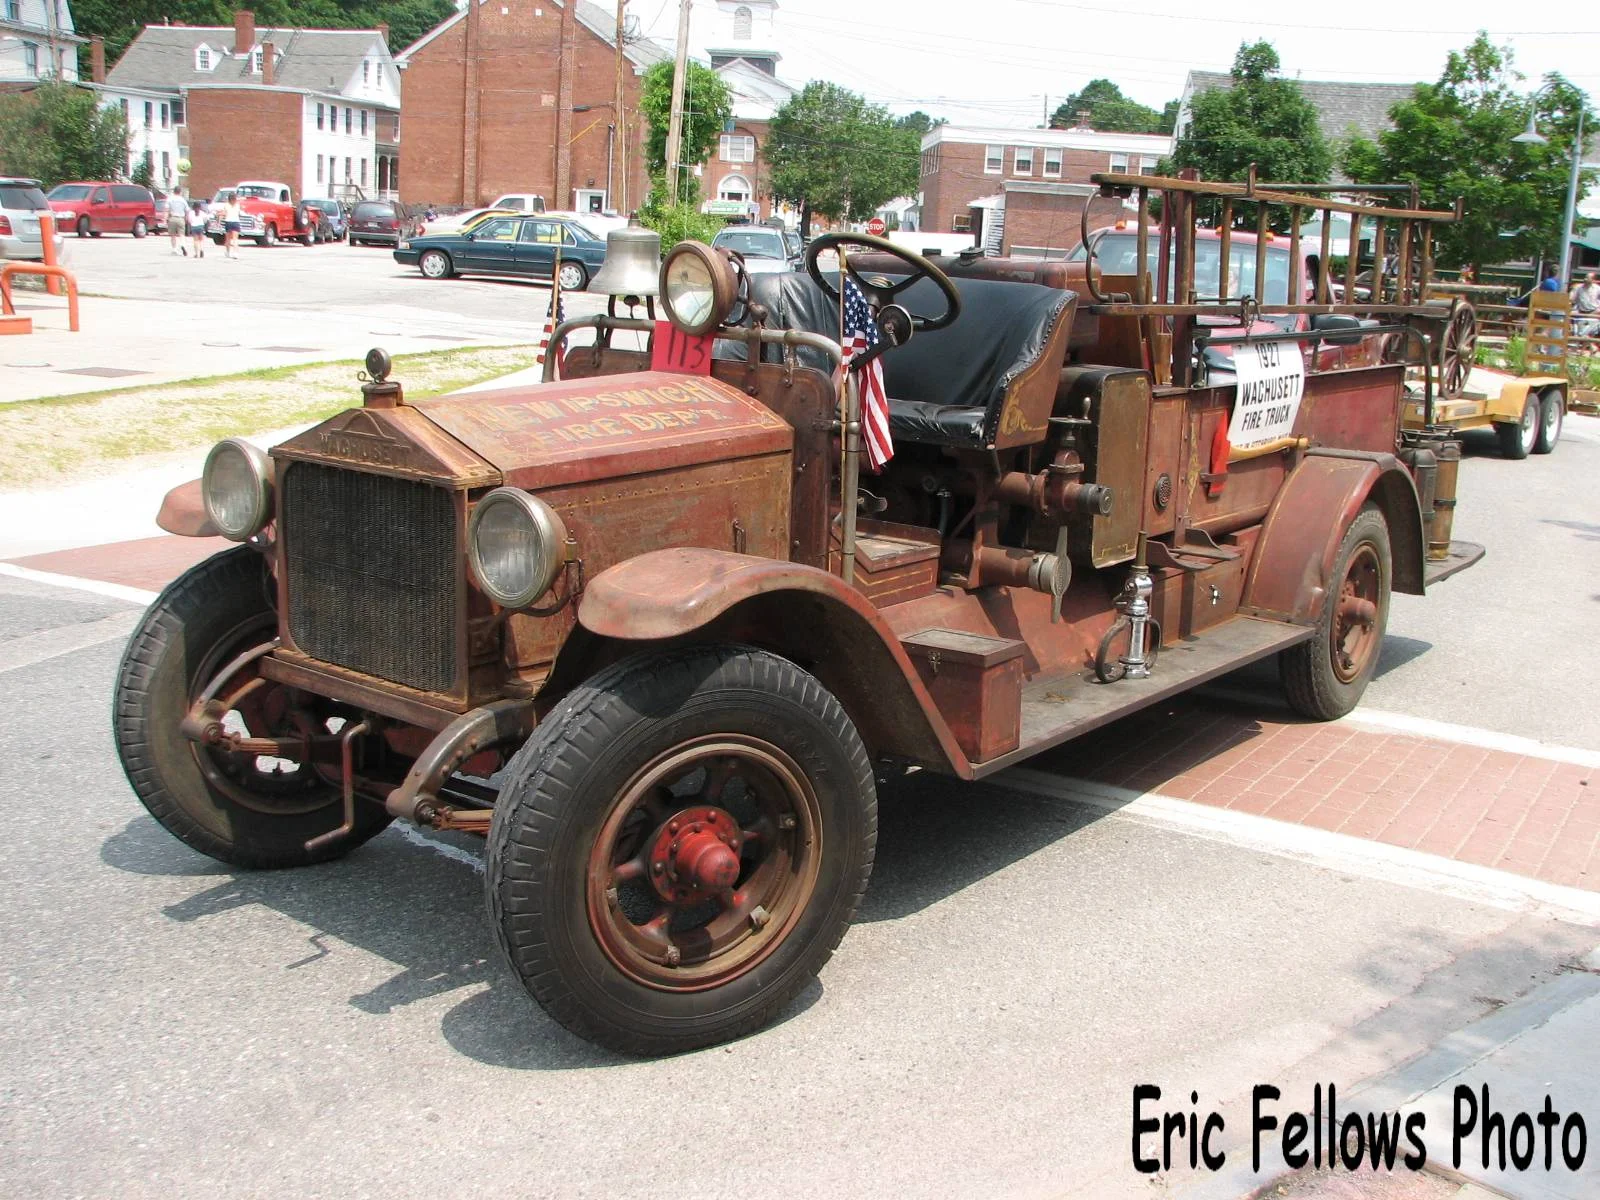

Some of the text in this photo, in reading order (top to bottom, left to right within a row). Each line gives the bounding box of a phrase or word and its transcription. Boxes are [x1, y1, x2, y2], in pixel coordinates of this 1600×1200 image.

[869, 223, 884, 231] STOP
[667, 327, 705, 369] 113
[1255, 342, 1280, 368] 1927
[1241, 374, 1300, 407] WACHUSETT
[466, 379, 732, 432] NEW IPSWICH
[1241, 404, 1291, 431] FIRE TRUCK
[526, 418, 633, 447] FIRE
